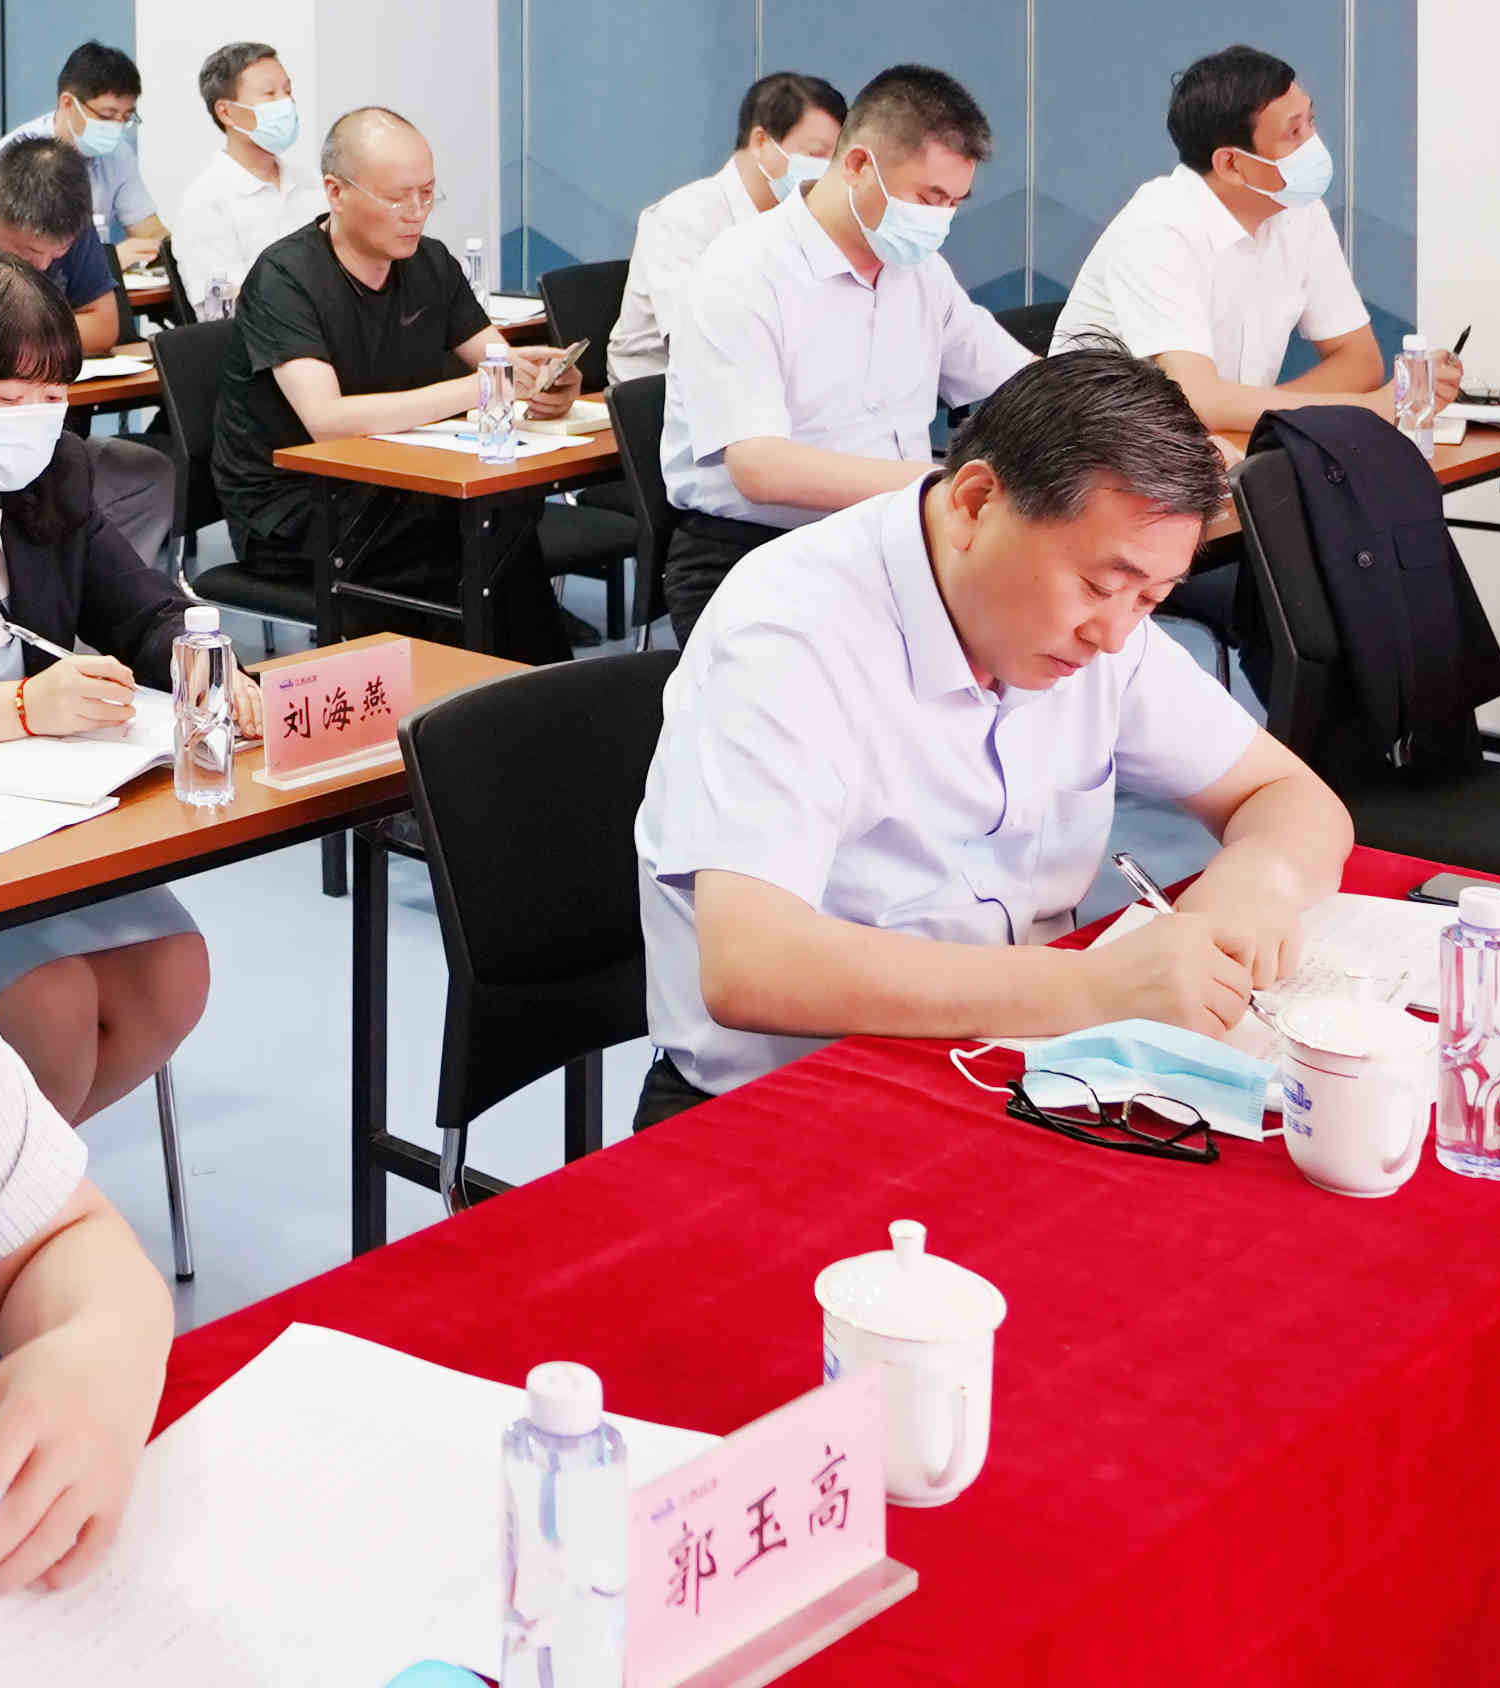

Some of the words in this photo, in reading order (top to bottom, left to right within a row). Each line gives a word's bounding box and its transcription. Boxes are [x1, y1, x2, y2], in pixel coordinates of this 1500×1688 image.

[283, 675, 391, 738] 刘海燕
[664, 1444, 850, 1616] 郭玉高
